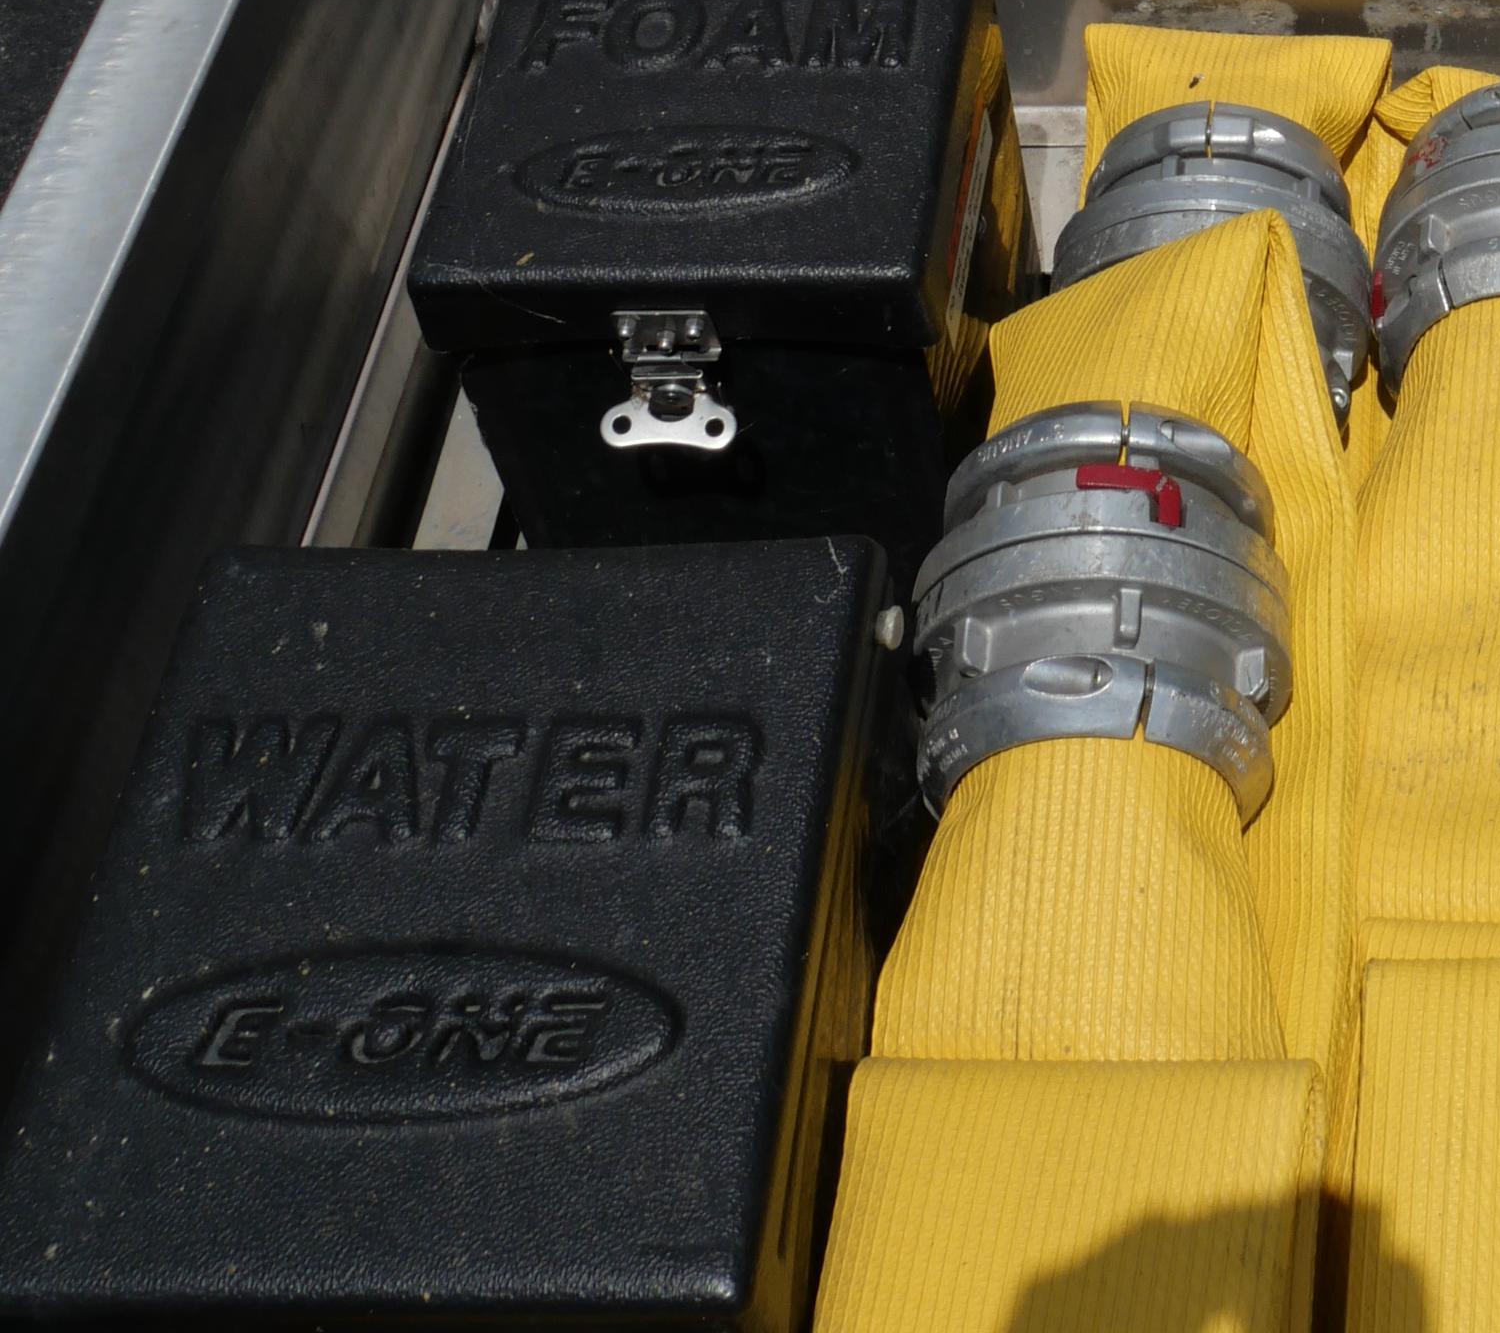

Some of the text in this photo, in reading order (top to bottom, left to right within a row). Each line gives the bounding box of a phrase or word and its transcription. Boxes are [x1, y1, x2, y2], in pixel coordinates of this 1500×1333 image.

[558, 134, 819, 192] E-ONE
[976, 428, 1034, 463] ANGUS
[175, 709, 768, 851] WATER
[197, 994, 610, 1071] E-ONE
